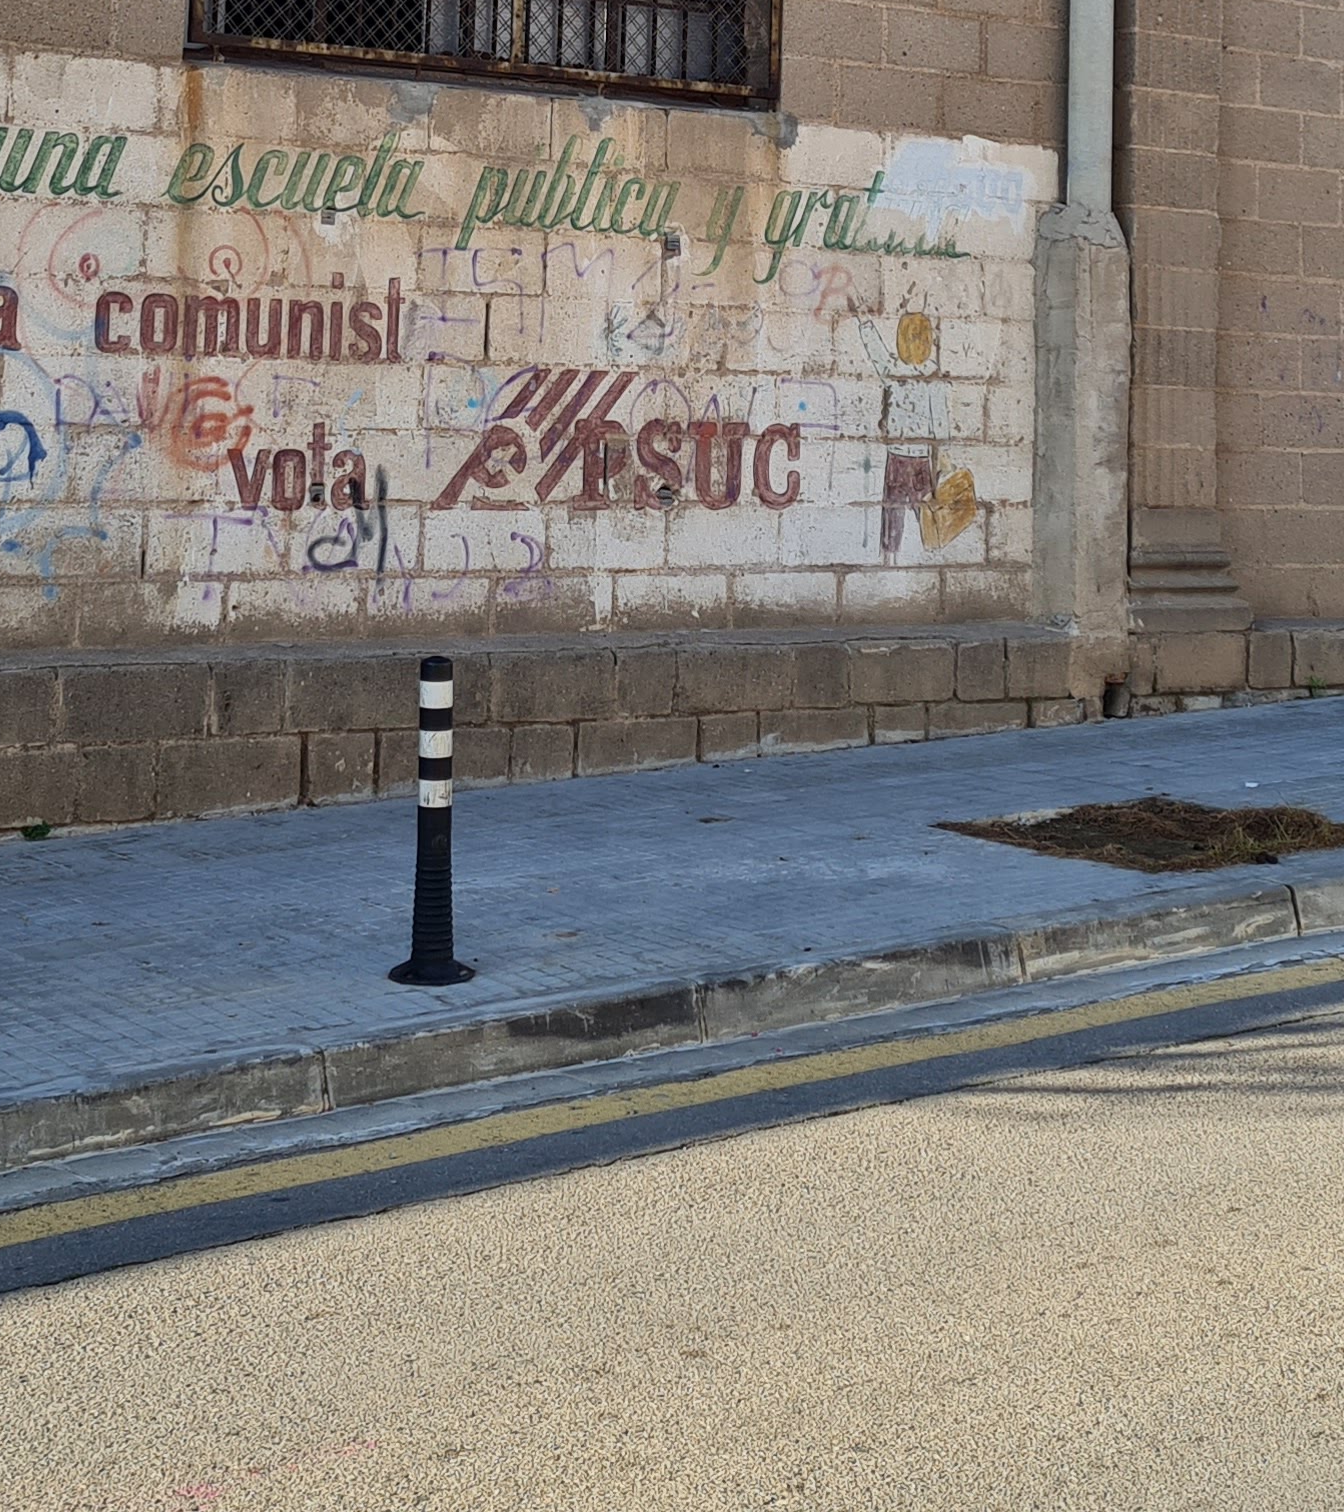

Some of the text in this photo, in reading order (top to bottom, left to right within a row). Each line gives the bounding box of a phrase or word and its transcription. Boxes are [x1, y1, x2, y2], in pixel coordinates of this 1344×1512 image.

[161, 131, 424, 219] escuela
[226, 418, 800, 511] vota PSUC
